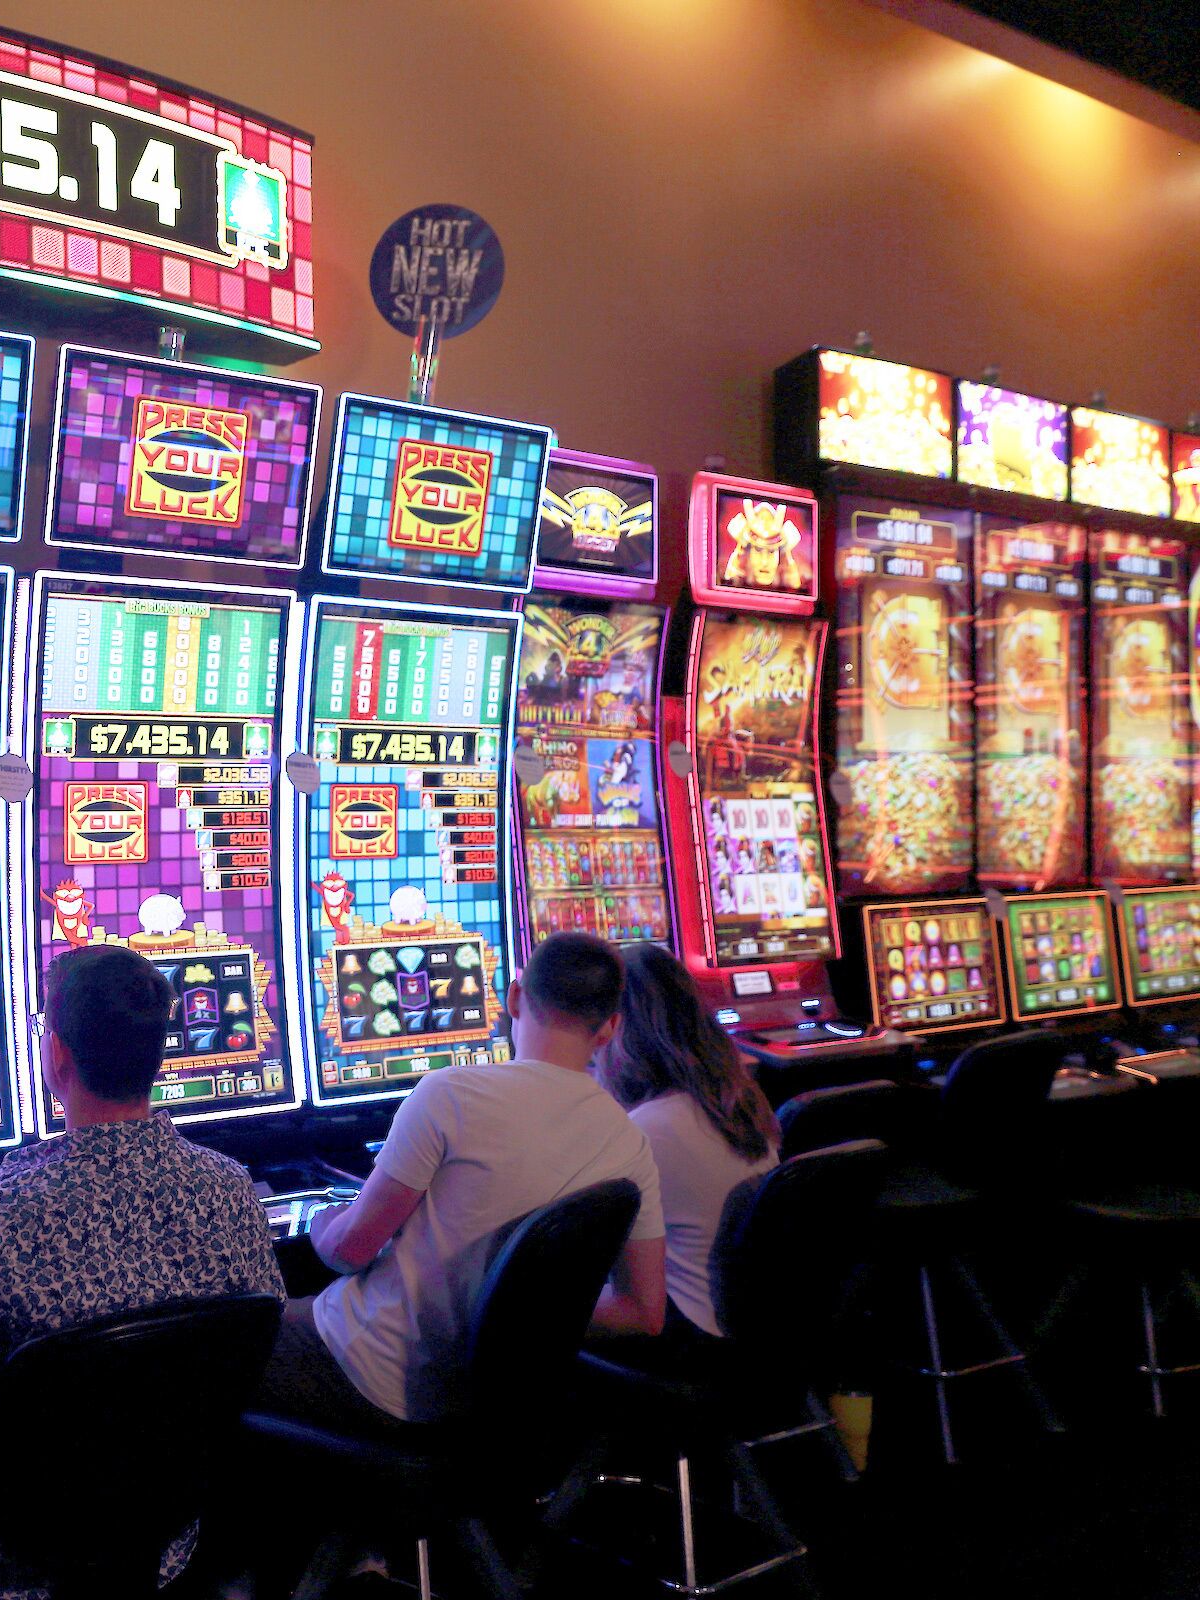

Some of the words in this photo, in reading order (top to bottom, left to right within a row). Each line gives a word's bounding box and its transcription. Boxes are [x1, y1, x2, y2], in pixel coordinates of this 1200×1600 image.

[410, 217, 471, 247] HOT
[390, 244, 483, 297] NEW
[392, 294, 470, 324] SLOT
[139, 402, 245, 453] PRESS
[139, 443, 240, 478] YOUR
[401, 446, 486, 486] PRESS
[134, 470, 237, 519] LUCK
[401, 482, 482, 513] YOUR
[395, 507, 477, 548] LUCK
[90, 722, 230, 756] $7,435.14
[351, 732, 465, 763] $7,435.14
[203, 767, 268, 783] $2,036.56
[70, 786, 143, 813] PRESS
[218, 790, 268, 805] $351.15
[335, 789, 394, 812] PRESS
[70, 814, 142, 830] YOUR
[222, 811, 267, 825] $126.51
[335, 814, 393, 828] YOUR
[71, 833, 143, 859] LUCK
[229, 832, 268, 846] $40.00
[335, 832, 393, 854] LUCK
[231, 853, 268, 867] $20.00
[232, 872, 268, 887] $10.57
[224, 964, 243, 977] BAR
